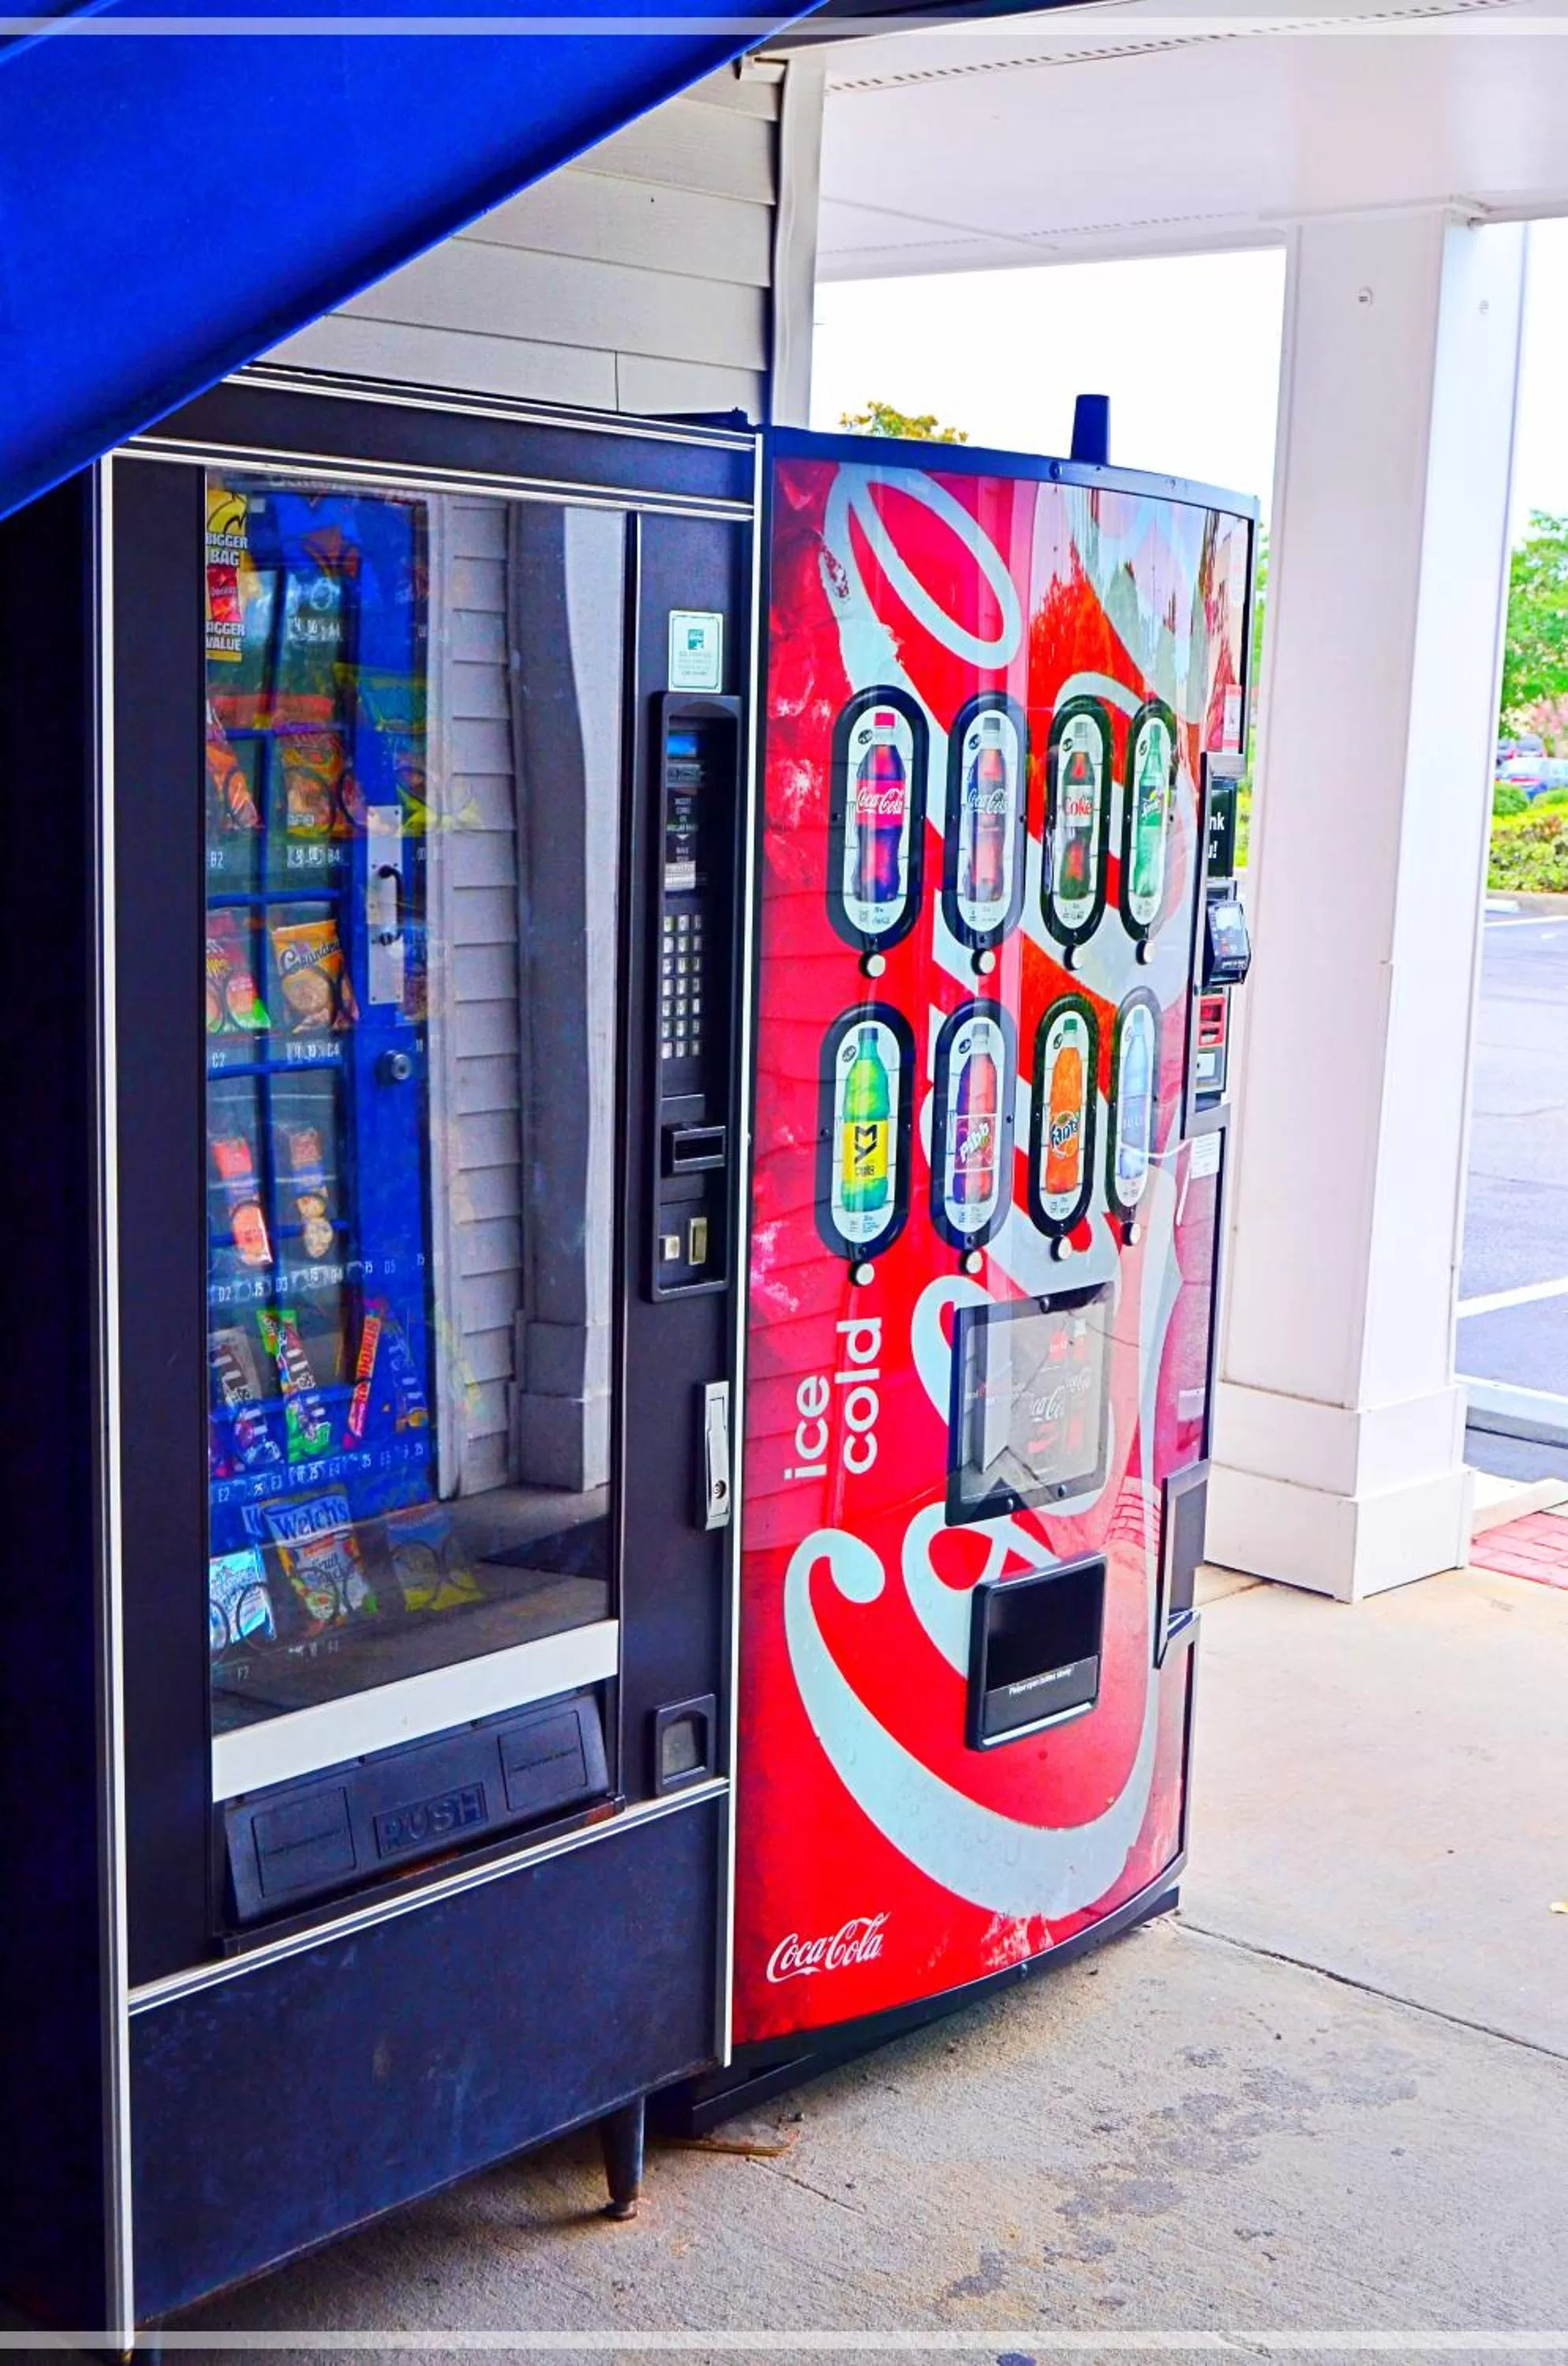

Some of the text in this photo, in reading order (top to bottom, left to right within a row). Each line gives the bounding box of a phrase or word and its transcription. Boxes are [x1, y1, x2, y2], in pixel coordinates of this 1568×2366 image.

[211, 549, 240, 566] BAG
[206, 636, 241, 651] VALUE
[783, 1375, 831, 1480] ice
[834, 1316, 883, 1474] cold
[380, 1787, 483, 1852] PUSH
[766, 1911, 891, 1983] Coca-Cola
